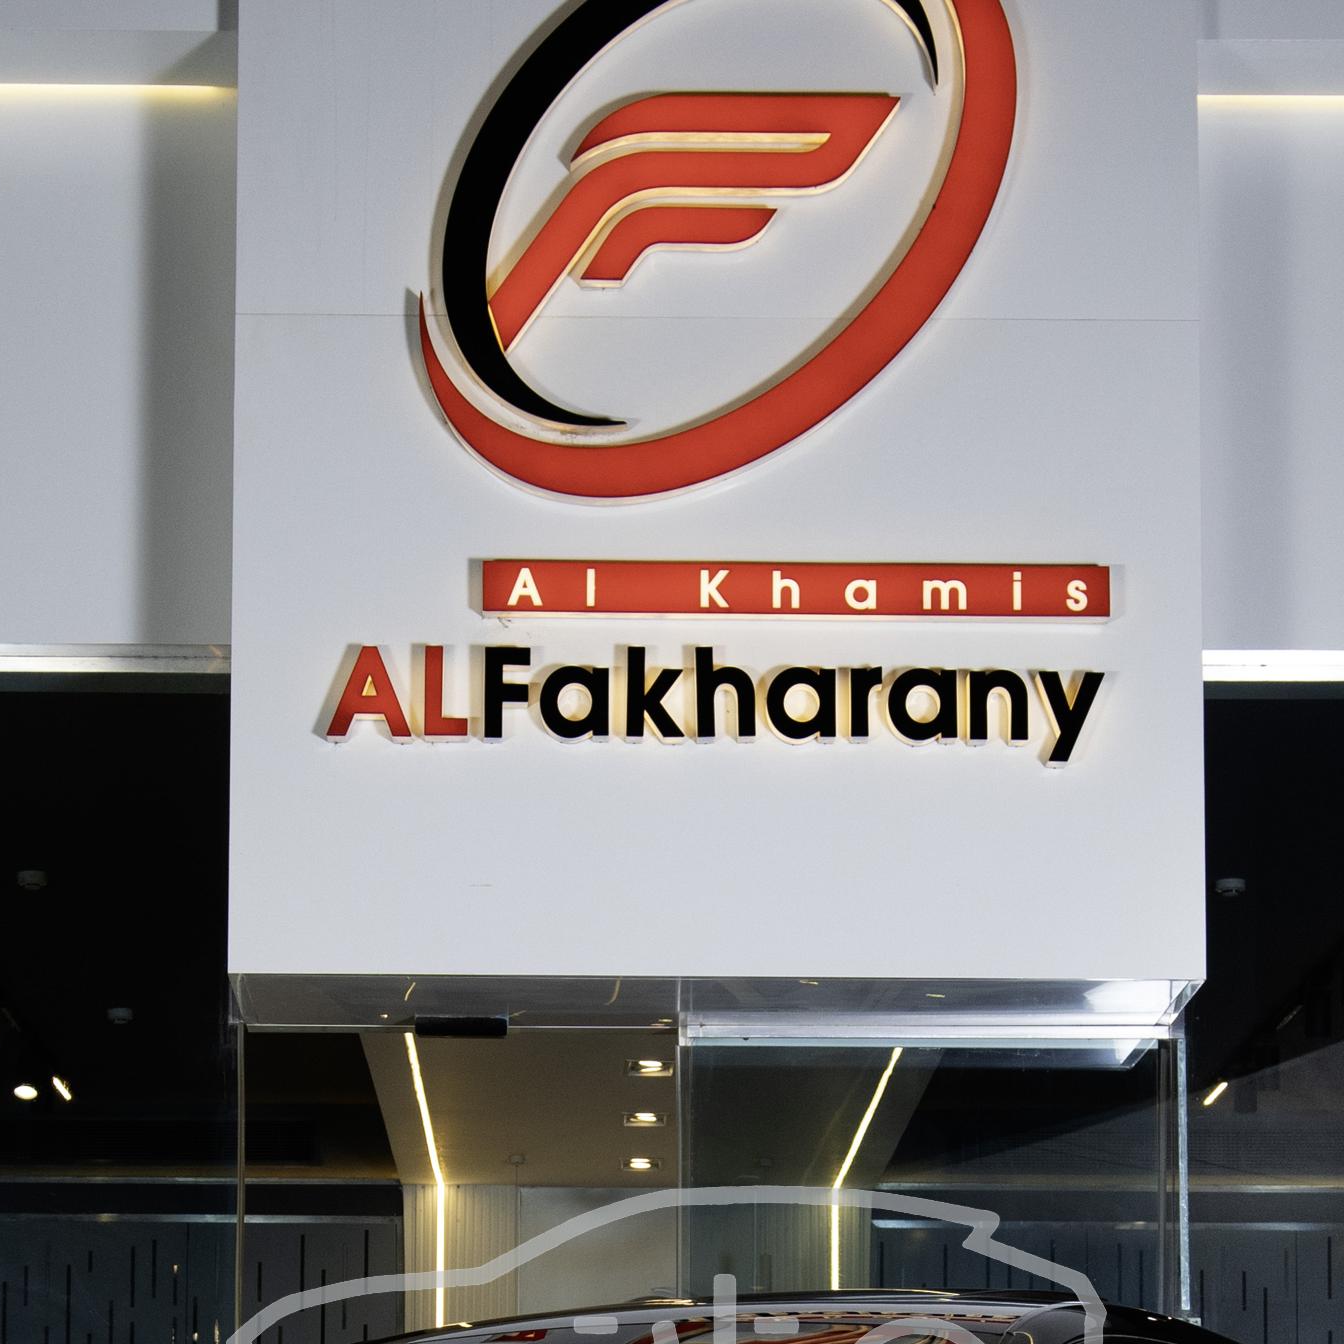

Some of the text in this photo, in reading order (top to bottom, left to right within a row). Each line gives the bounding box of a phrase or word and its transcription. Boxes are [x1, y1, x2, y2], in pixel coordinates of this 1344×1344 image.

[506, 566, 1090, 612] Al Khamis
[326, 645, 1106, 764] ALFakharany
